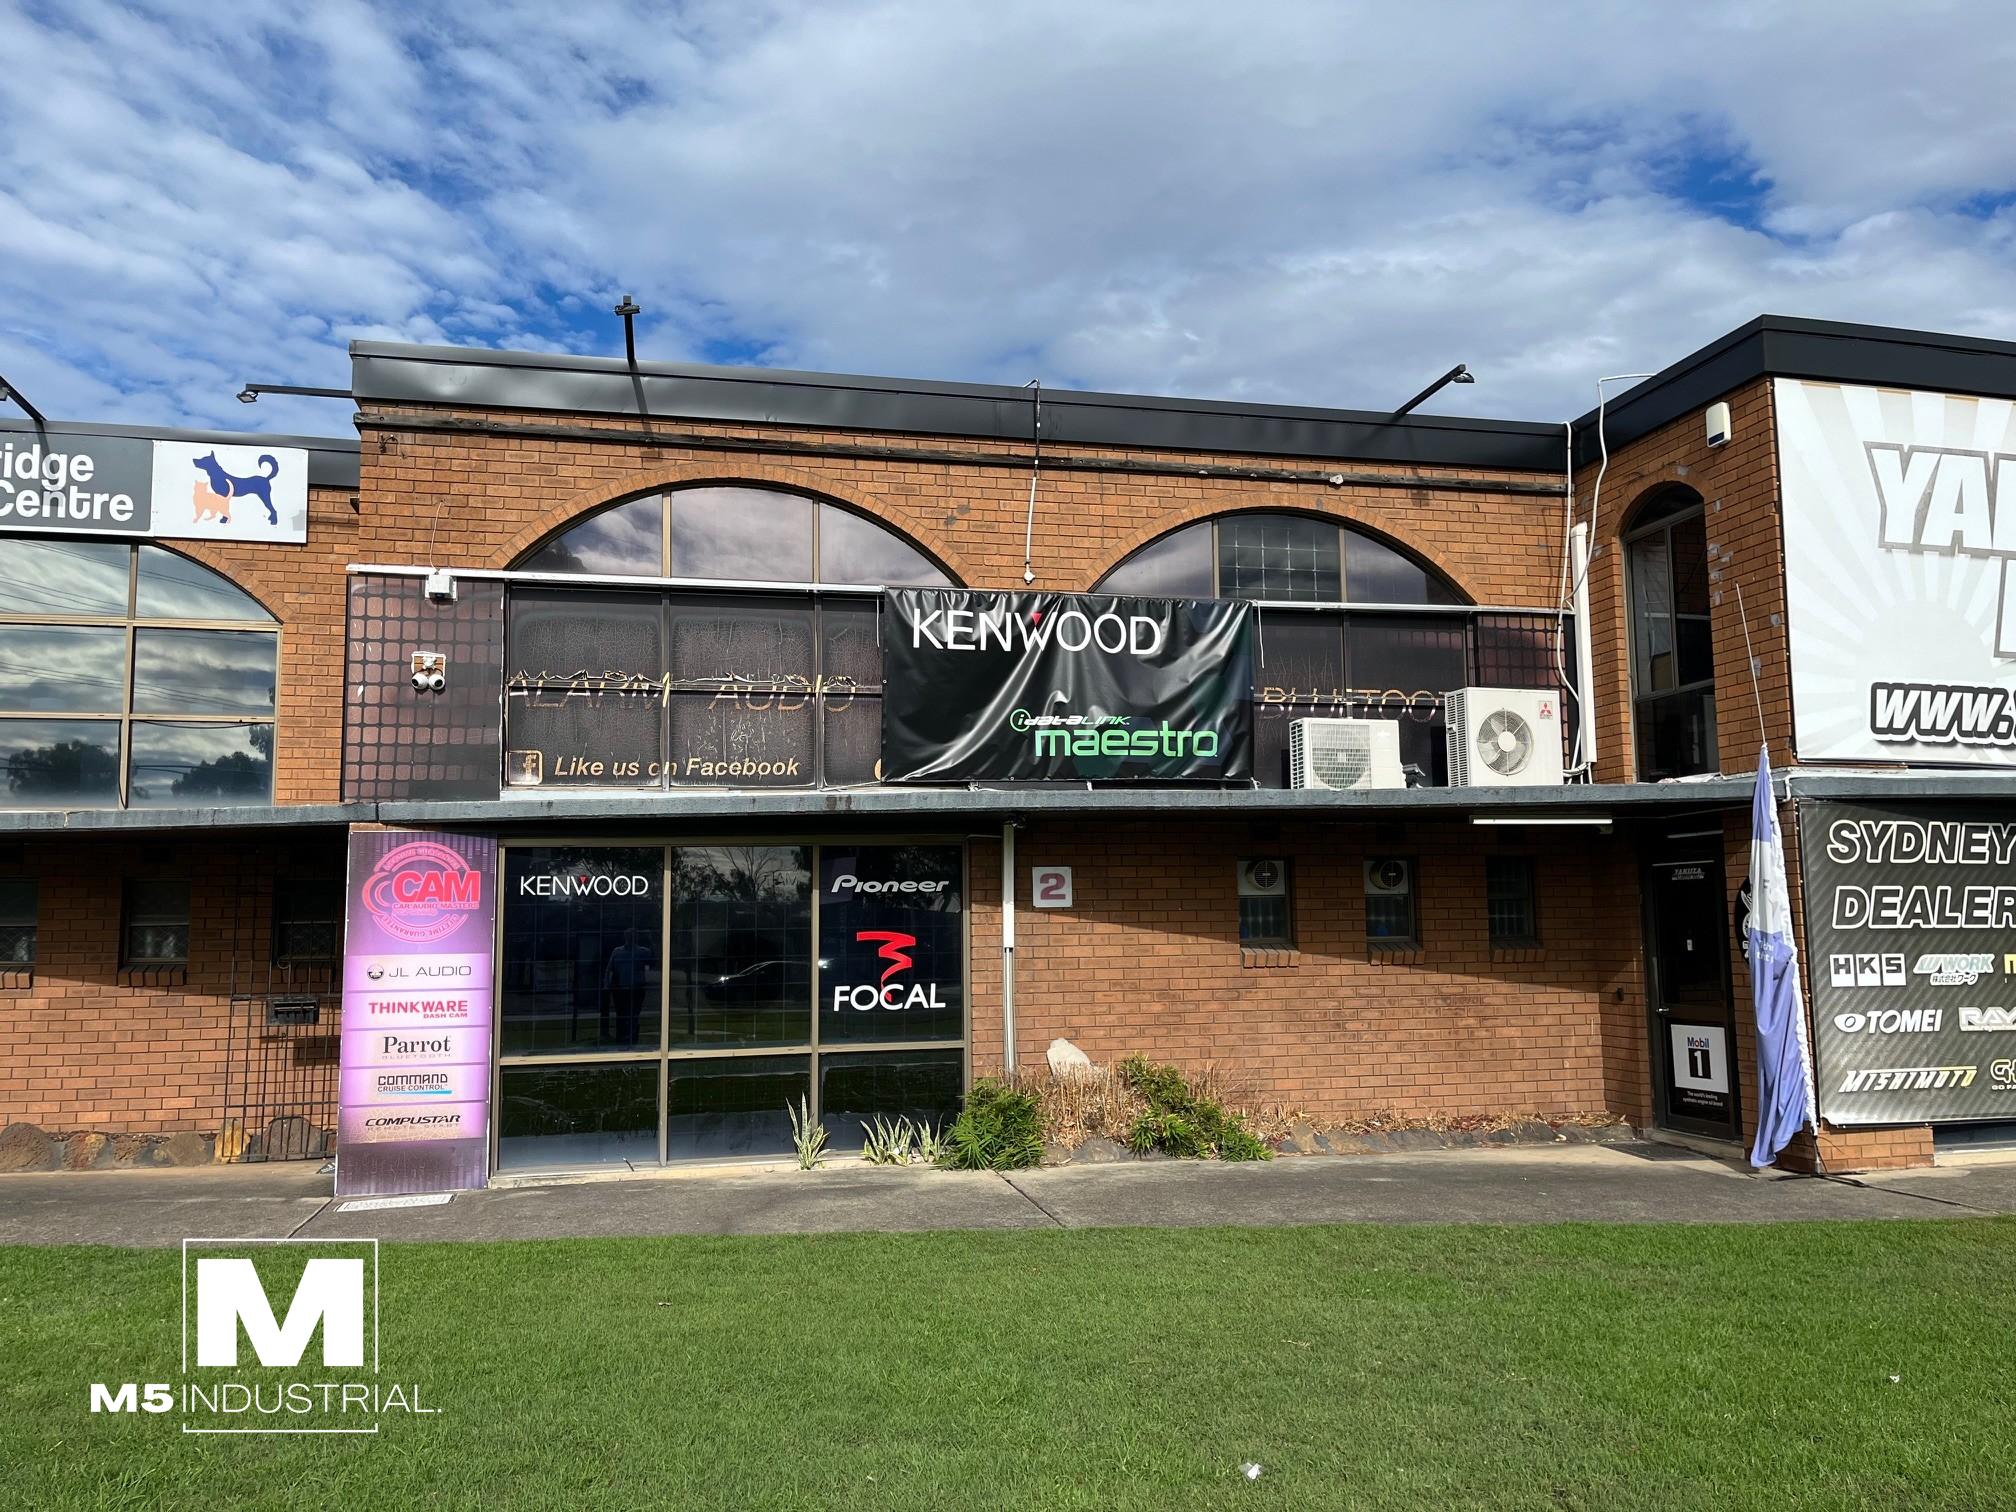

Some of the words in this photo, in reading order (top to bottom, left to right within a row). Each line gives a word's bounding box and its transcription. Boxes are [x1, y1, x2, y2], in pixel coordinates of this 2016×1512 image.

[0, 443, 94, 491] idge
[1863, 441, 2016, 554] YA
[912, 608, 1161, 655] KENWOOD
[1035, 720, 1219, 757] maestro
[554, 755, 604, 777] Like
[612, 761, 640, 777] us
[648, 761, 678, 777] on
[686, 757, 800, 777] Facebook
[1827, 819, 2016, 864] SYDNEY
[392, 870, 481, 903] CAM
[520, 875, 649, 896] KENWOOD
[831, 874, 950, 894] Pioneer
[1038, 872, 1067, 901] 2
[1832, 886, 2016, 929] DEALER
[388, 966, 409, 978] JL
[415, 965, 472, 977] AUDIO
[1831, 955, 1905, 981] HKS
[1941, 955, 1994, 973] WORK
[368, 1000, 468, 1014] THINKWARE
[833, 983, 947, 1012] FOCAL
[1867, 1009, 1943, 1034] TOMEI
[383, 1035, 451, 1054] Parrot
[1687, 1036, 1710, 1049] Mobil
[1694, 1050, 1703, 1077] 1
[377, 1085, 406, 1093] CRUISE
[408, 1084, 444, 1092] CONTROL
[378, 1073, 448, 1086] COMMAND
[1838, 1065, 1978, 1093] MISHIMOTO
[365, 1114, 461, 1127] COMPUSTAR
